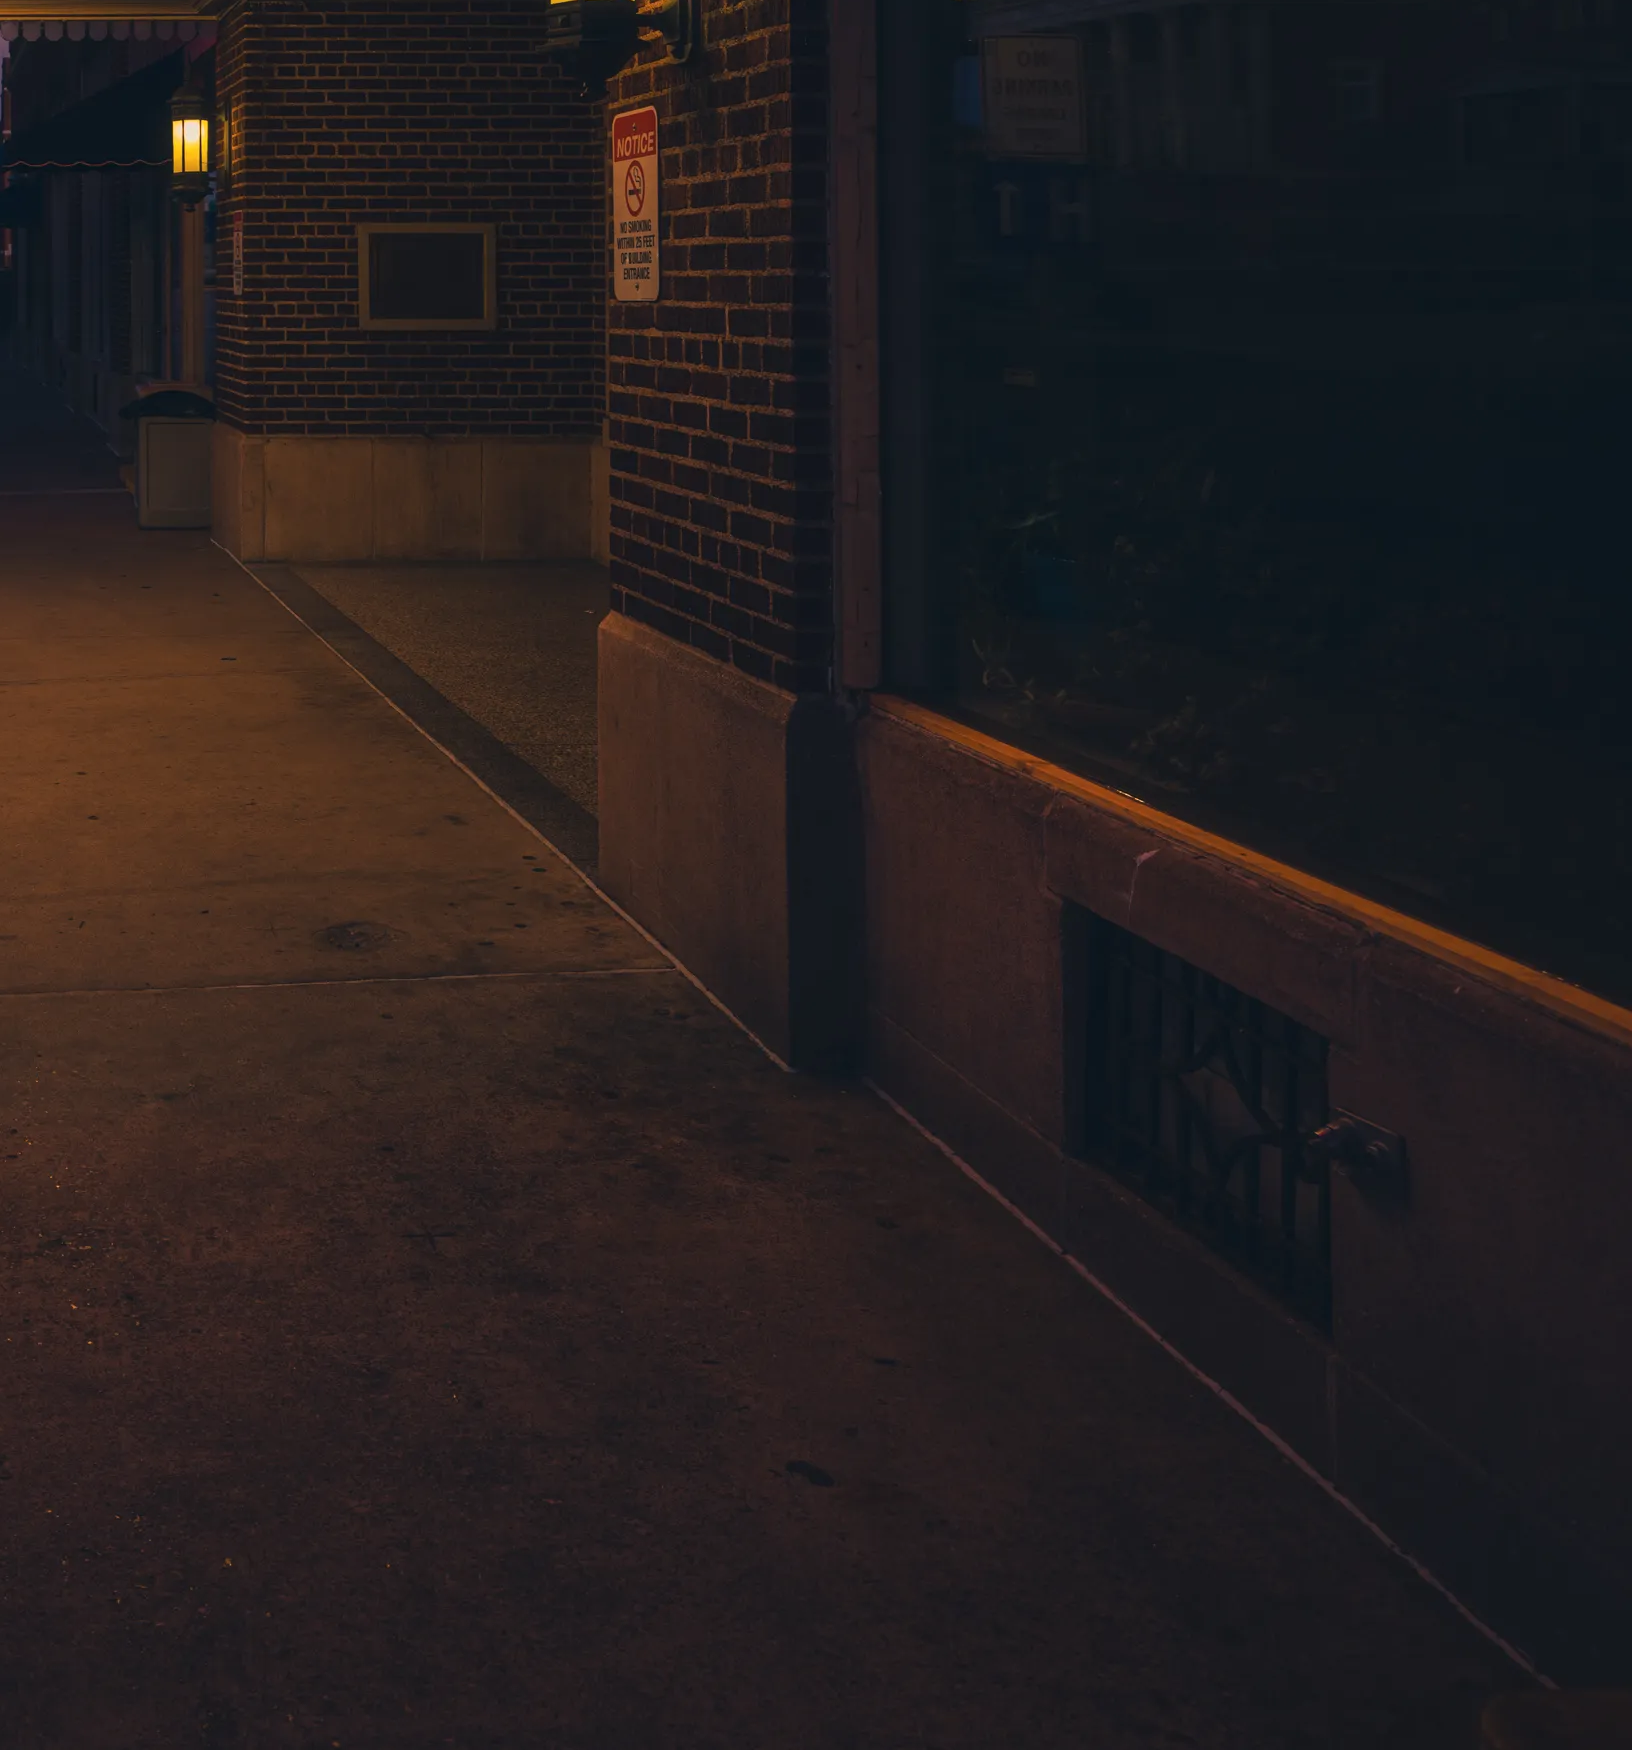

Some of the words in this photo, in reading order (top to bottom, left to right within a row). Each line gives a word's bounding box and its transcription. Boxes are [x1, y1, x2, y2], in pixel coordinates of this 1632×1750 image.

[616, 131, 655, 158] NOTICE
[620, 222, 628, 233] NO
[628, 219, 652, 233] SMOKING
[617, 237, 635, 249] WITHIN
[643, 235, 655, 247] FEET
[621, 252, 628, 264] OF
[628, 251, 652, 264] BUILDING
[623, 267, 651, 280] ENTRANCE
